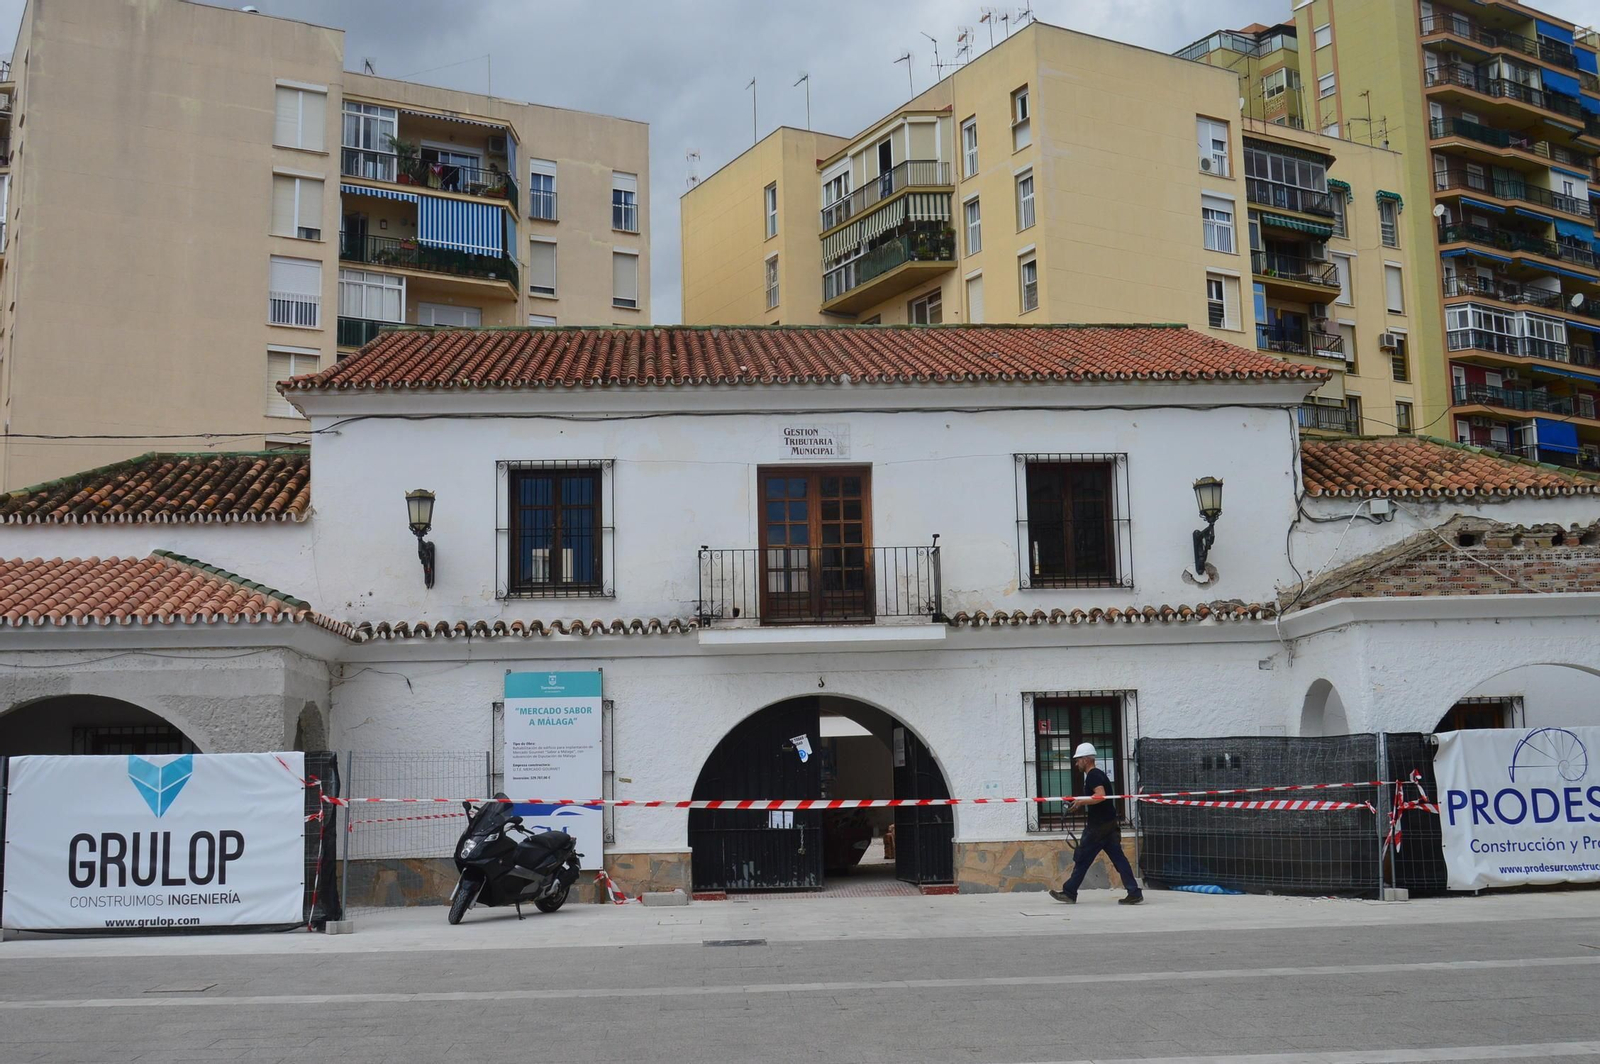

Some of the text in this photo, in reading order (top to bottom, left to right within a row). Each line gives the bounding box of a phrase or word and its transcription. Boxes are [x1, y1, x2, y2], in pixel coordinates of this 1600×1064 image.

[784, 428, 818, 436] GESTION
[784, 437, 833, 446] TRIBUTARIA
[791, 446, 834, 455] MUNICIPAL
[564, 706, 592, 714] SABOR
[1447, 786, 1600, 826] PRODES
[1470, 836, 1600, 854] Construcción y Pr
[68, 830, 245, 888] GRULOP
[1498, 862, 1600, 874] www.prodesurconstruc
[70, 890, 241, 908] CONSTRUIMOS INGENIERÍA
[105, 916, 200, 928] www.grulop.com
